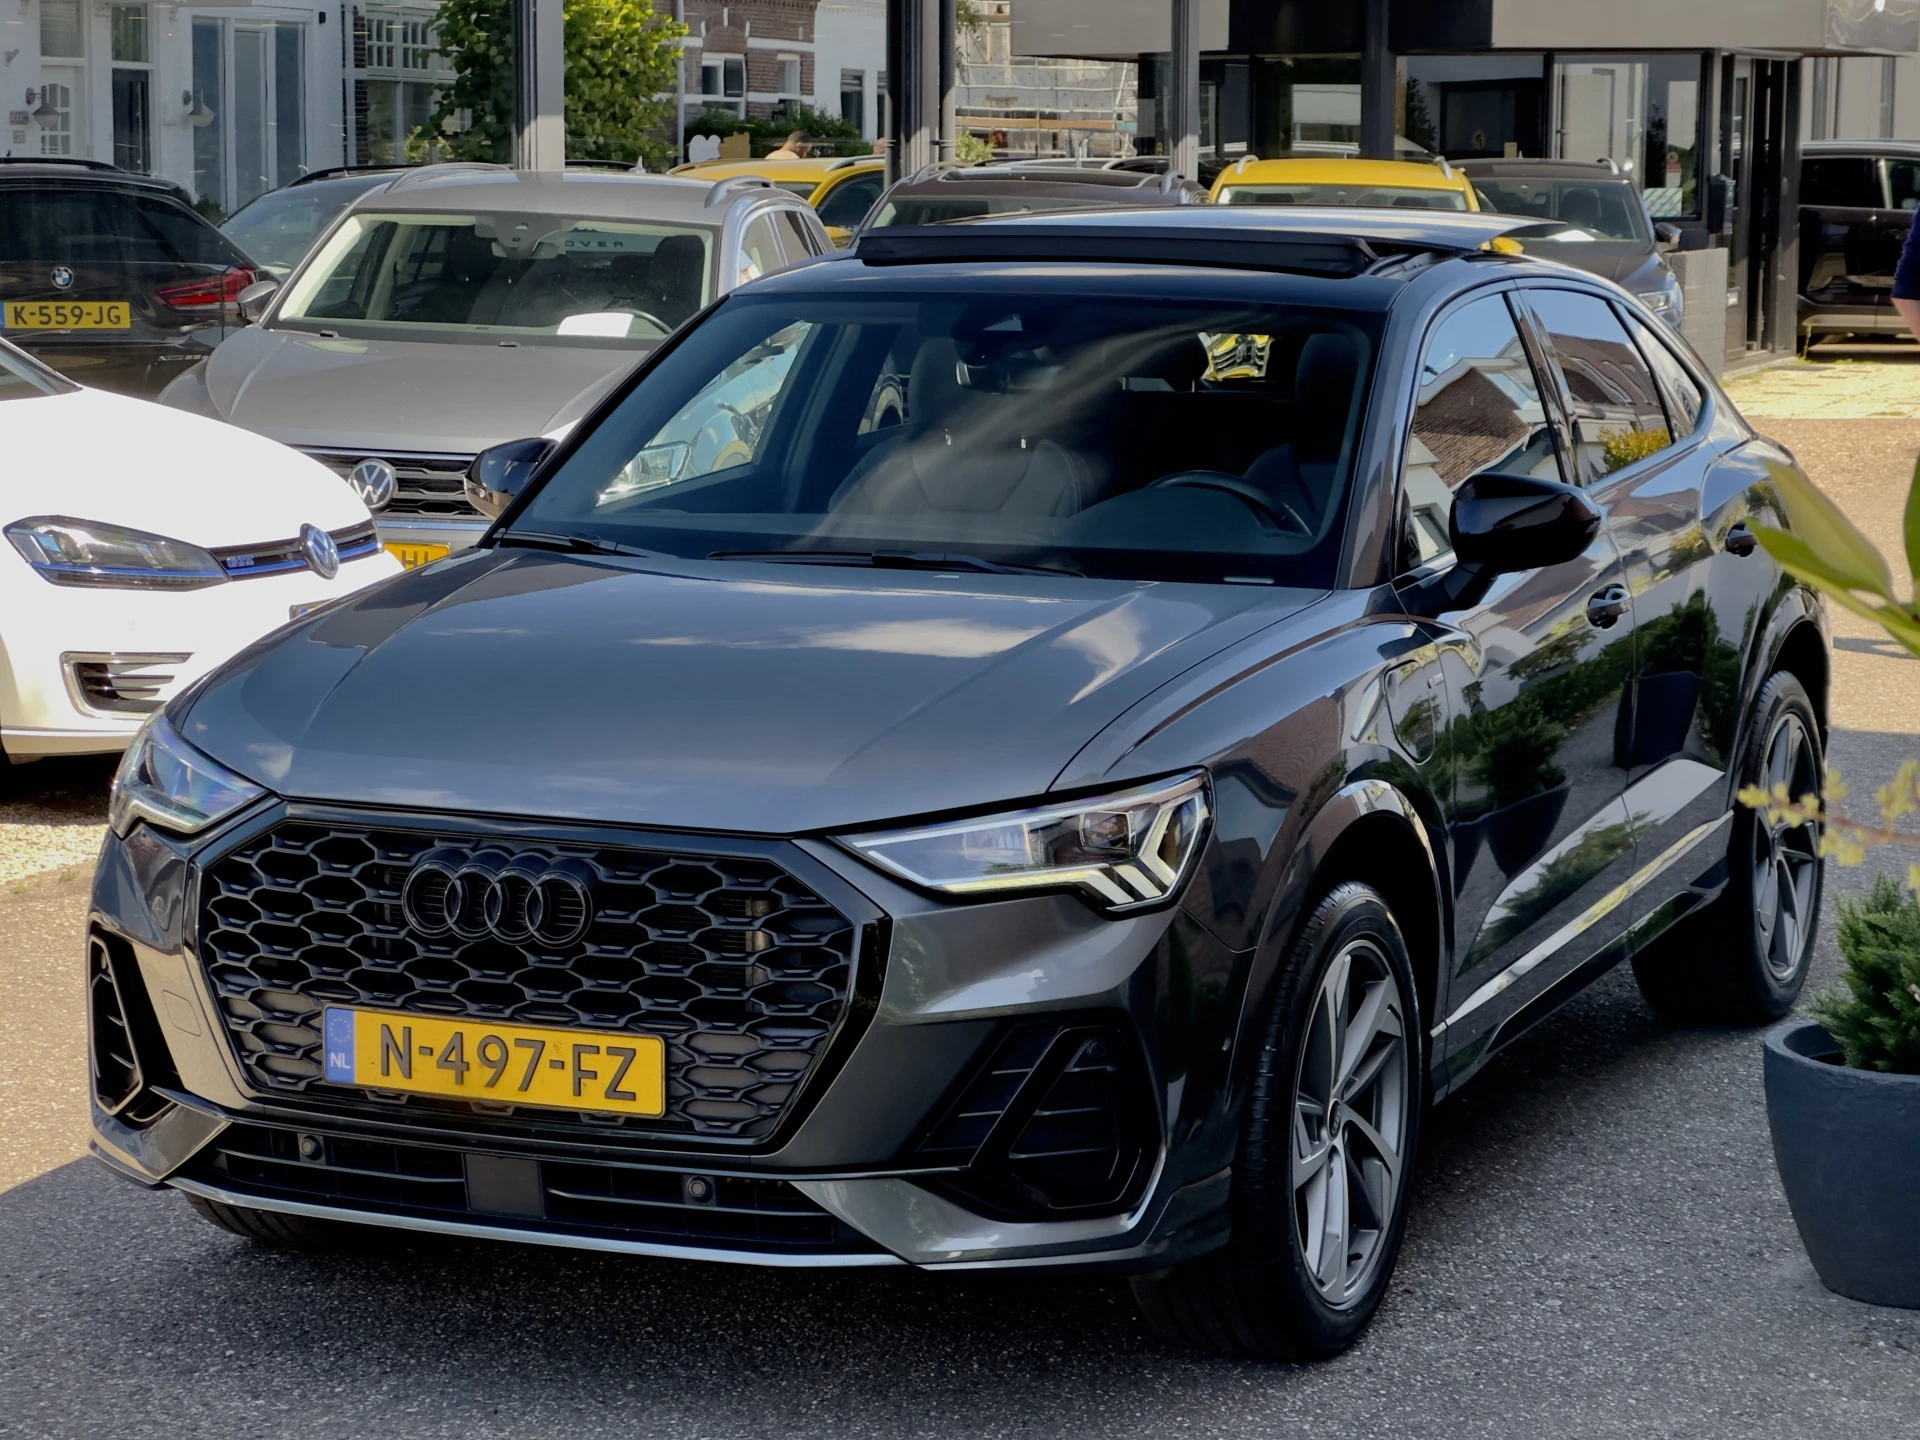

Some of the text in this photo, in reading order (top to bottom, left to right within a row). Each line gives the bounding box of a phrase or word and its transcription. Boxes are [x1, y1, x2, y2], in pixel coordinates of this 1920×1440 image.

[13, 305, 121, 325] K-559-JG
[330, 1023, 637, 1101] NL N-497-FZ
